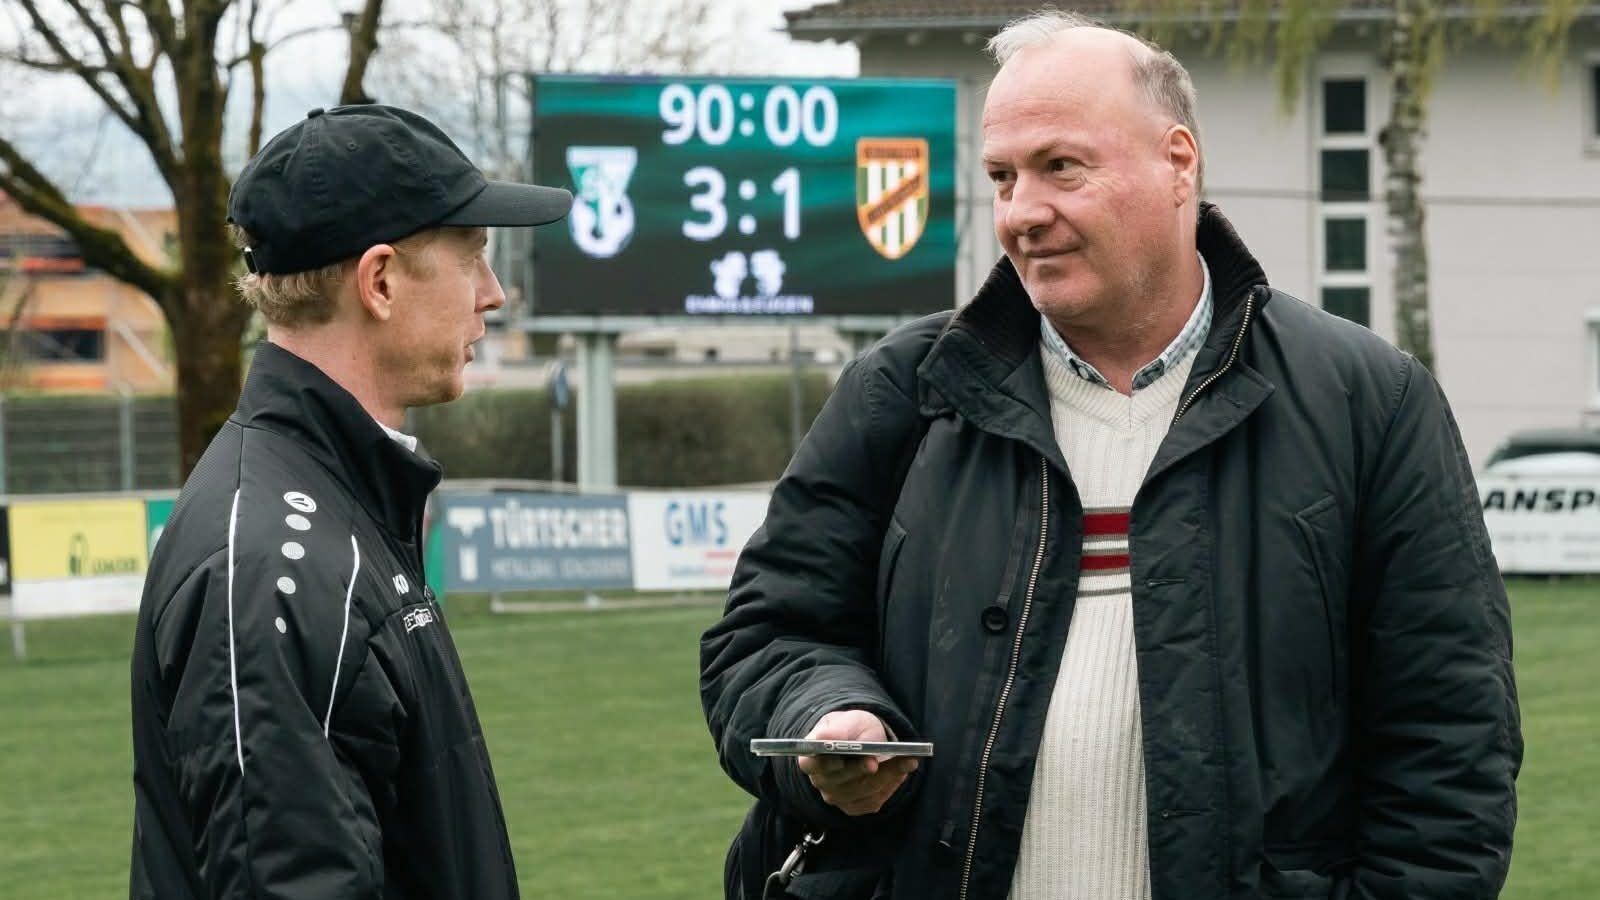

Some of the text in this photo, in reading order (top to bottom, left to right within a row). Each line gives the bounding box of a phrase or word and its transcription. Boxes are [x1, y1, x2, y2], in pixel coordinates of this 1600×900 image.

[659, 84, 839, 146] 90:00
[682, 166, 800, 241] 3:1
[489, 498, 627, 548] TÜRTSCHER
[664, 502, 729, 546] GMS
[1483, 488, 1600, 511] ANSP
